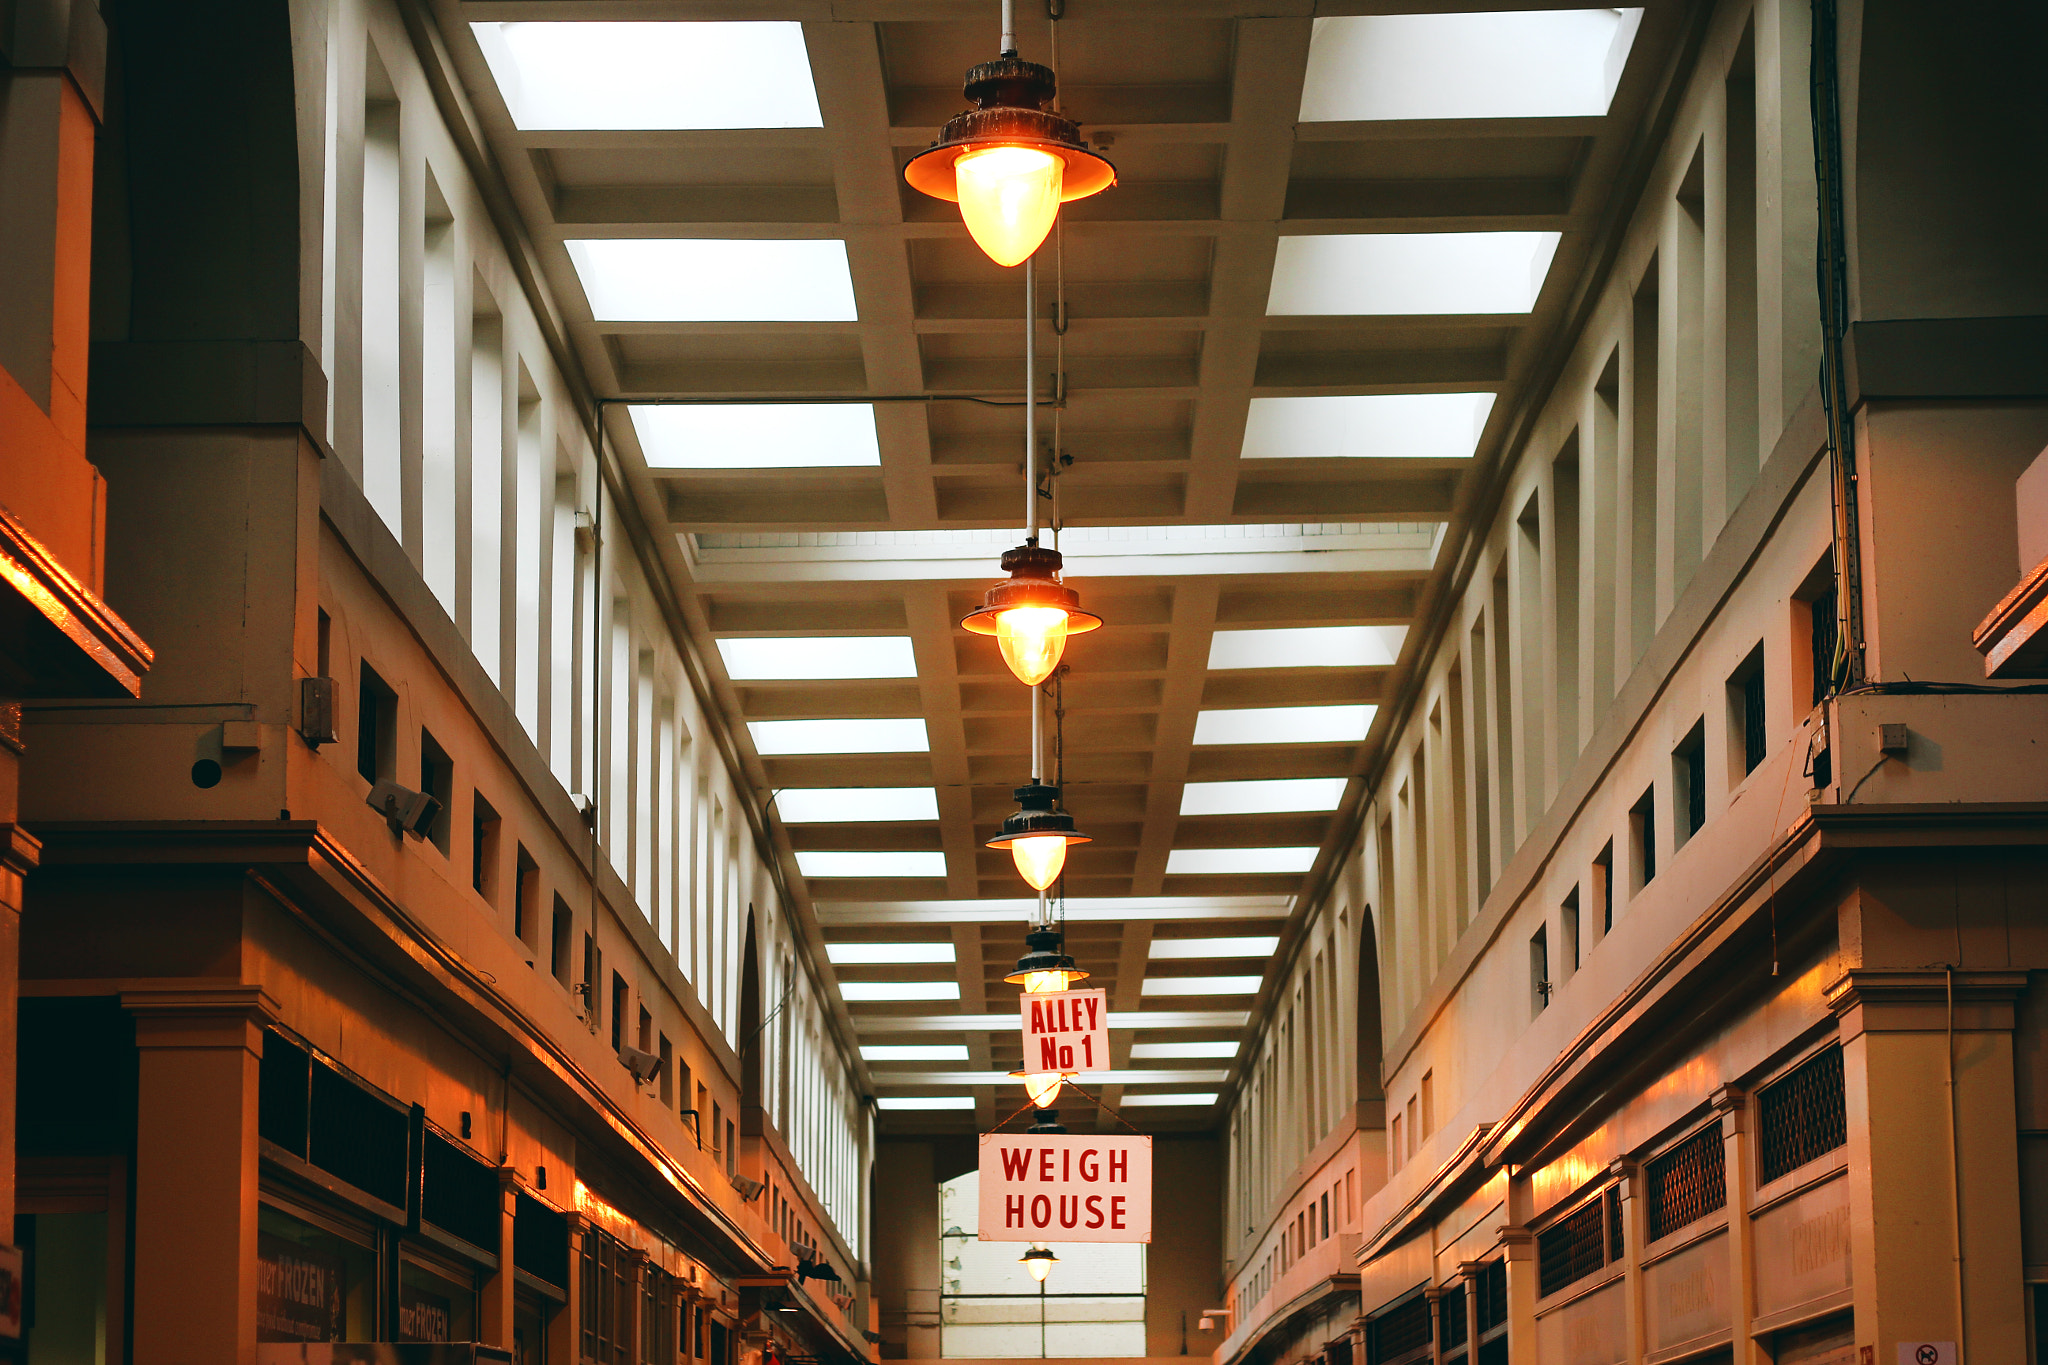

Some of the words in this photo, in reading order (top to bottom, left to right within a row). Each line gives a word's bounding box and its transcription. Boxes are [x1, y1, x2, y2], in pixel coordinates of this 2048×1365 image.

[1031, 998, 1098, 1034] ALLEY
[1040, 1036, 1074, 1070] No
[1081, 1034, 1093, 1068] 1
[1001, 1147, 1128, 1183] WEIGH
[1005, 1194, 1126, 1230] HOUSE
[278, 1254, 325, 1309] FROZEN
[416, 1302, 448, 1342] FROZEN
